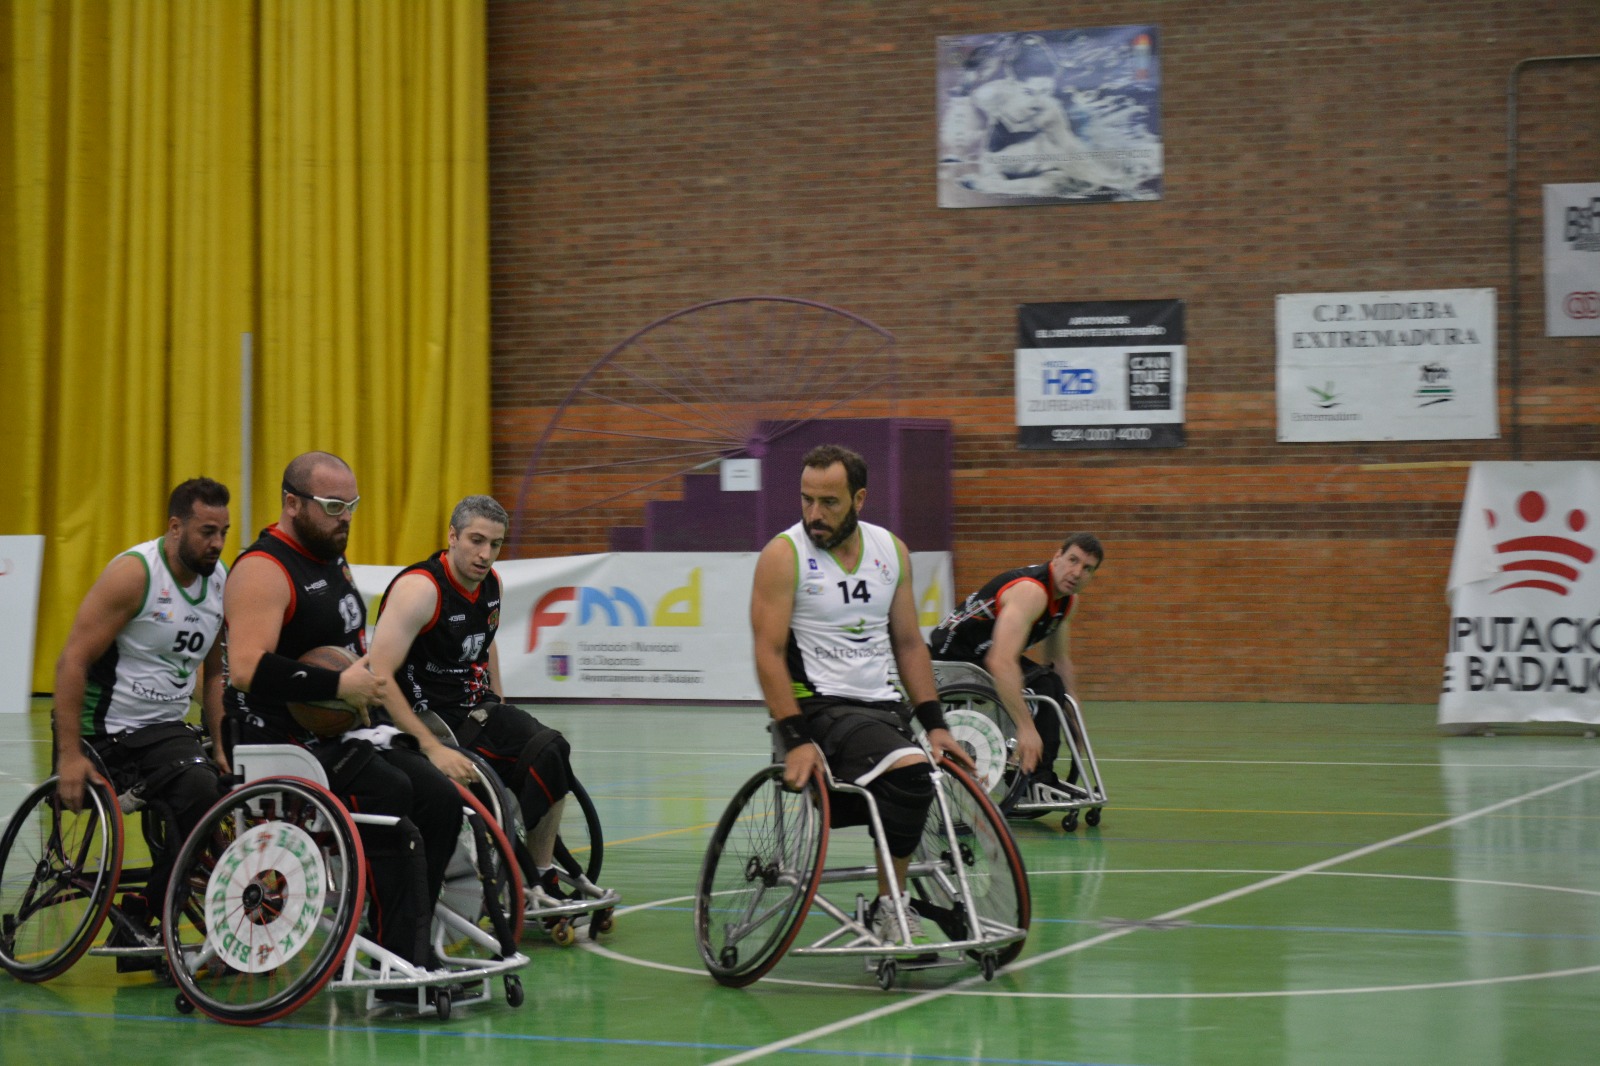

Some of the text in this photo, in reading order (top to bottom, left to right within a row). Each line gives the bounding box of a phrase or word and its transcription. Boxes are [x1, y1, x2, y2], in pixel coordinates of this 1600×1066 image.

[1361, 302, 1457, 320] MIDEBA
[1293, 328, 1480, 348] EXTREMADURA
[837, 580, 871, 604] 14
[172, 630, 204, 652] 50
[1466, 656, 1600, 693] BADAJ
